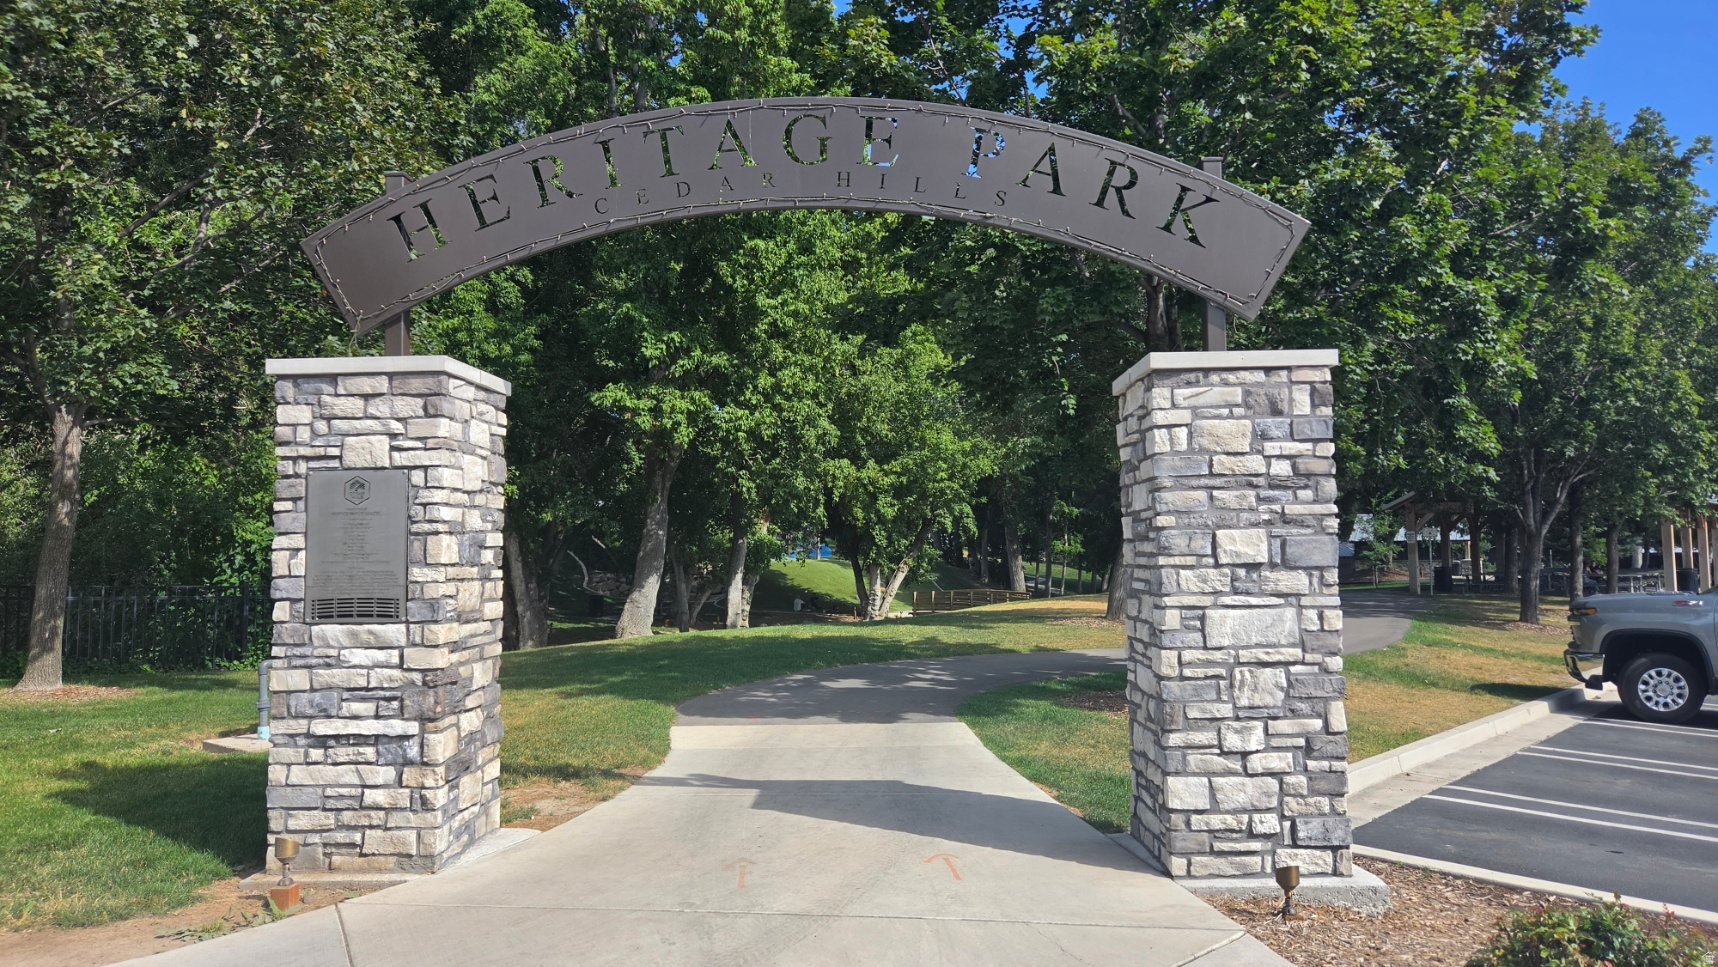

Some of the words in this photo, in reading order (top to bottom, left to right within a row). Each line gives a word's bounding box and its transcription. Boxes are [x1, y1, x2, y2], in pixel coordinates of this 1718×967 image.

[386, 114, 900, 263] HERITAGE
[961, 126, 1220, 249] PARK
[594, 171, 777, 215] CEDAR
[836, 171, 1007, 207] HILLS
